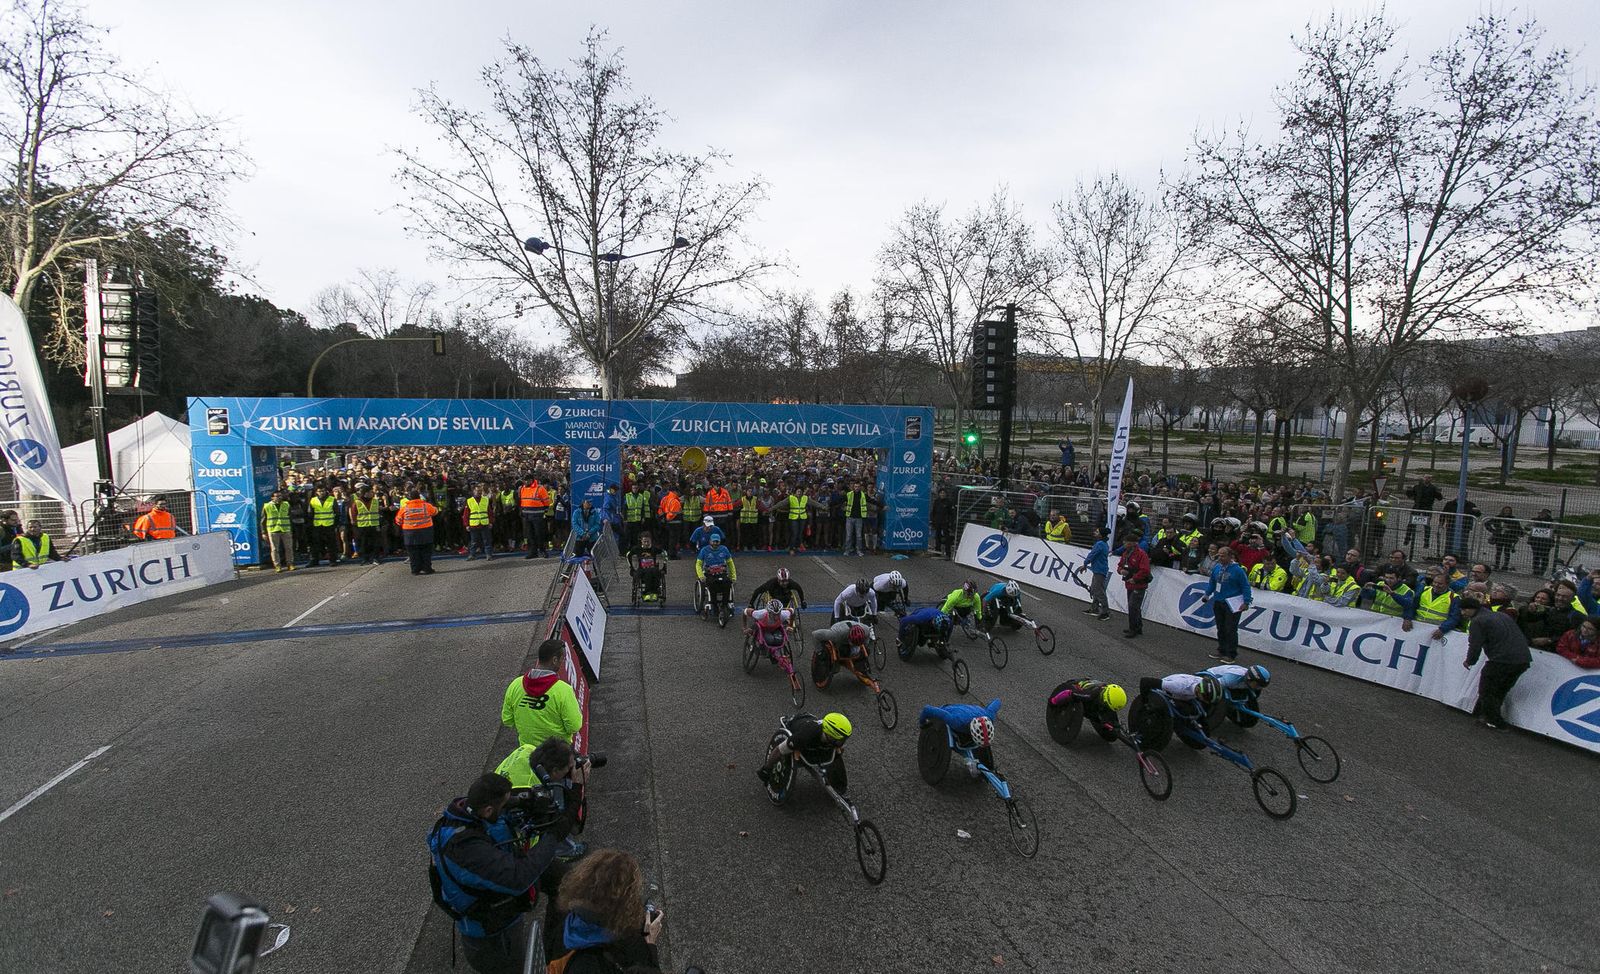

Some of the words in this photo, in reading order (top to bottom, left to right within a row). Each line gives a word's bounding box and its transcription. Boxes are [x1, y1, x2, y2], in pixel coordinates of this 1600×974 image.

[565, 408, 605, 417] ZURICH
[259, 416, 332, 431] ZURICH
[339, 413, 423, 431] MARATÓN
[428, 417, 448, 430] DE
[452, 417, 514, 430] SEVILLA
[565, 420, 605, 430] MARATÓN
[671, 419, 731, 433] ZURICH
[737, 418, 806, 434] MARATÓN
[811, 422, 828, 435] DE
[831, 423, 881, 436] SEVILLA
[565, 430, 606, 439] SEVILLA
[198, 468, 242, 477] ZURICH
[575, 464, 613, 472] ZURICH
[893, 466, 925, 474] ZURICH
[42, 554, 191, 611] ZURICH
[1238, 606, 1431, 677] ZURICH
